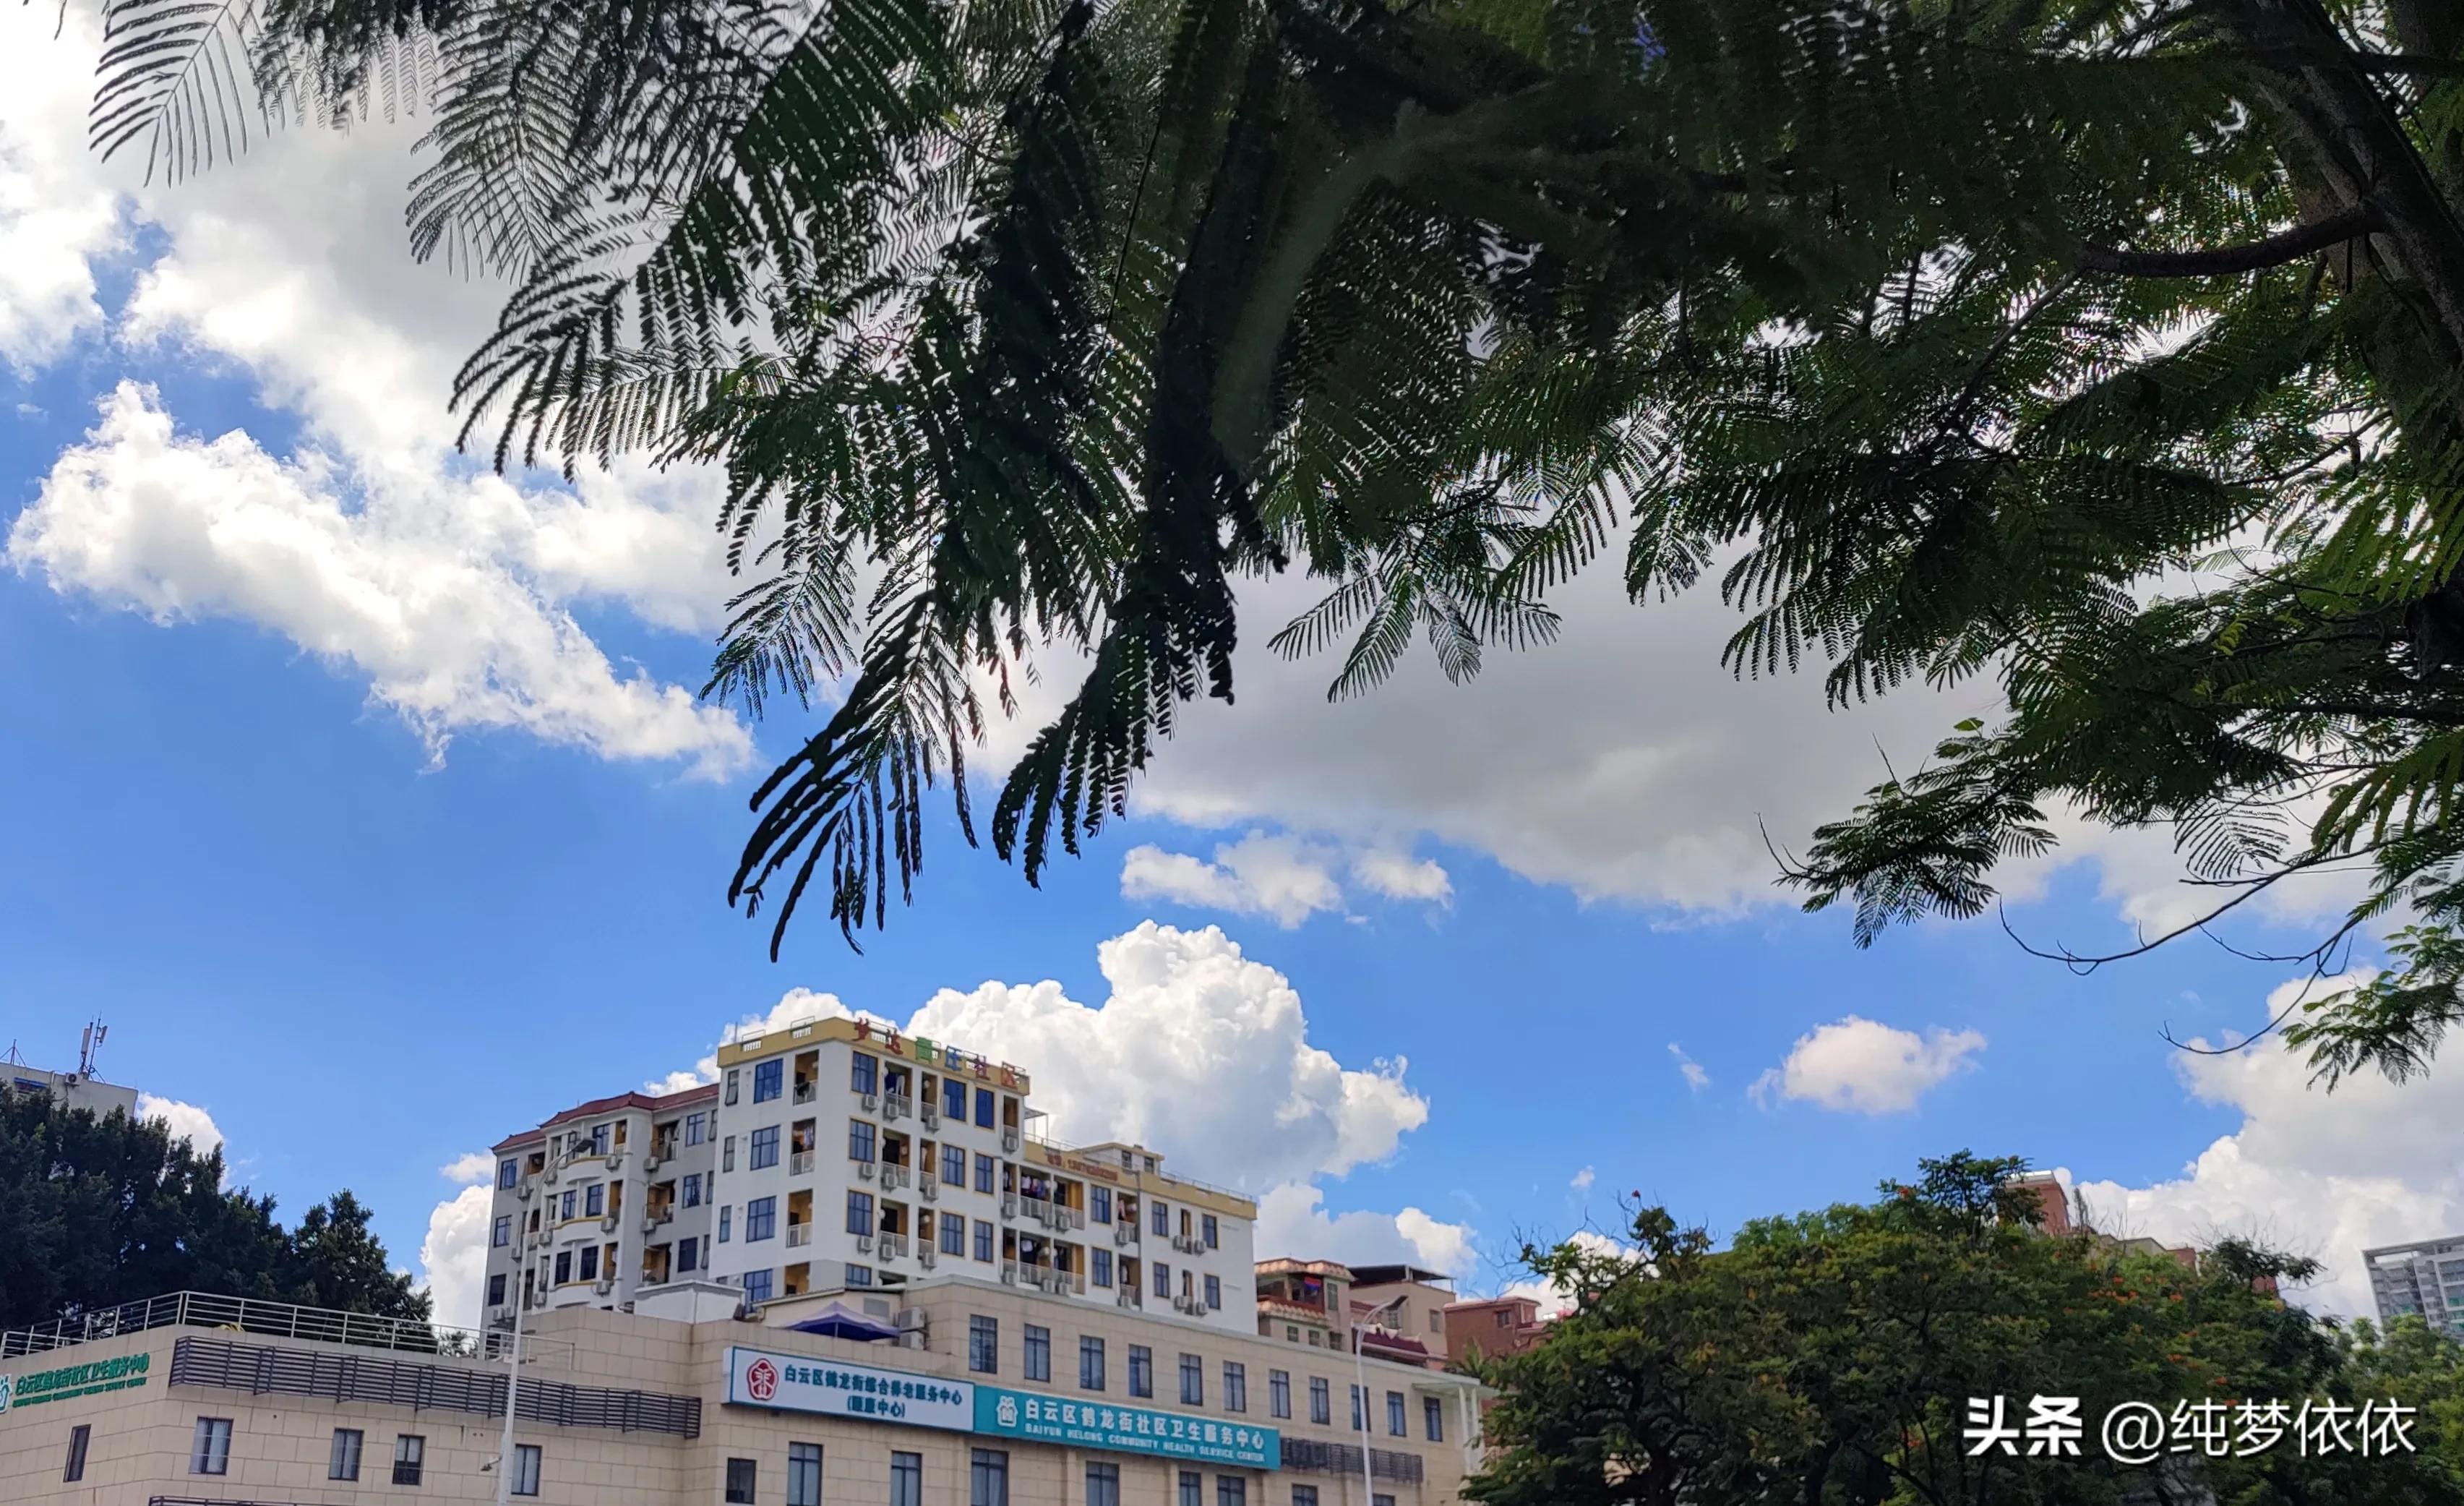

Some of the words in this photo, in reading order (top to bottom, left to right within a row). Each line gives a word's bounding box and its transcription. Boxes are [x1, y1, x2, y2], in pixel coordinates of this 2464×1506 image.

[1025, 1398, 1265, 1450] 白云区鹤龙街社区卫生服务中心
[1025, 1422, 1062, 1437] BAIYUN
